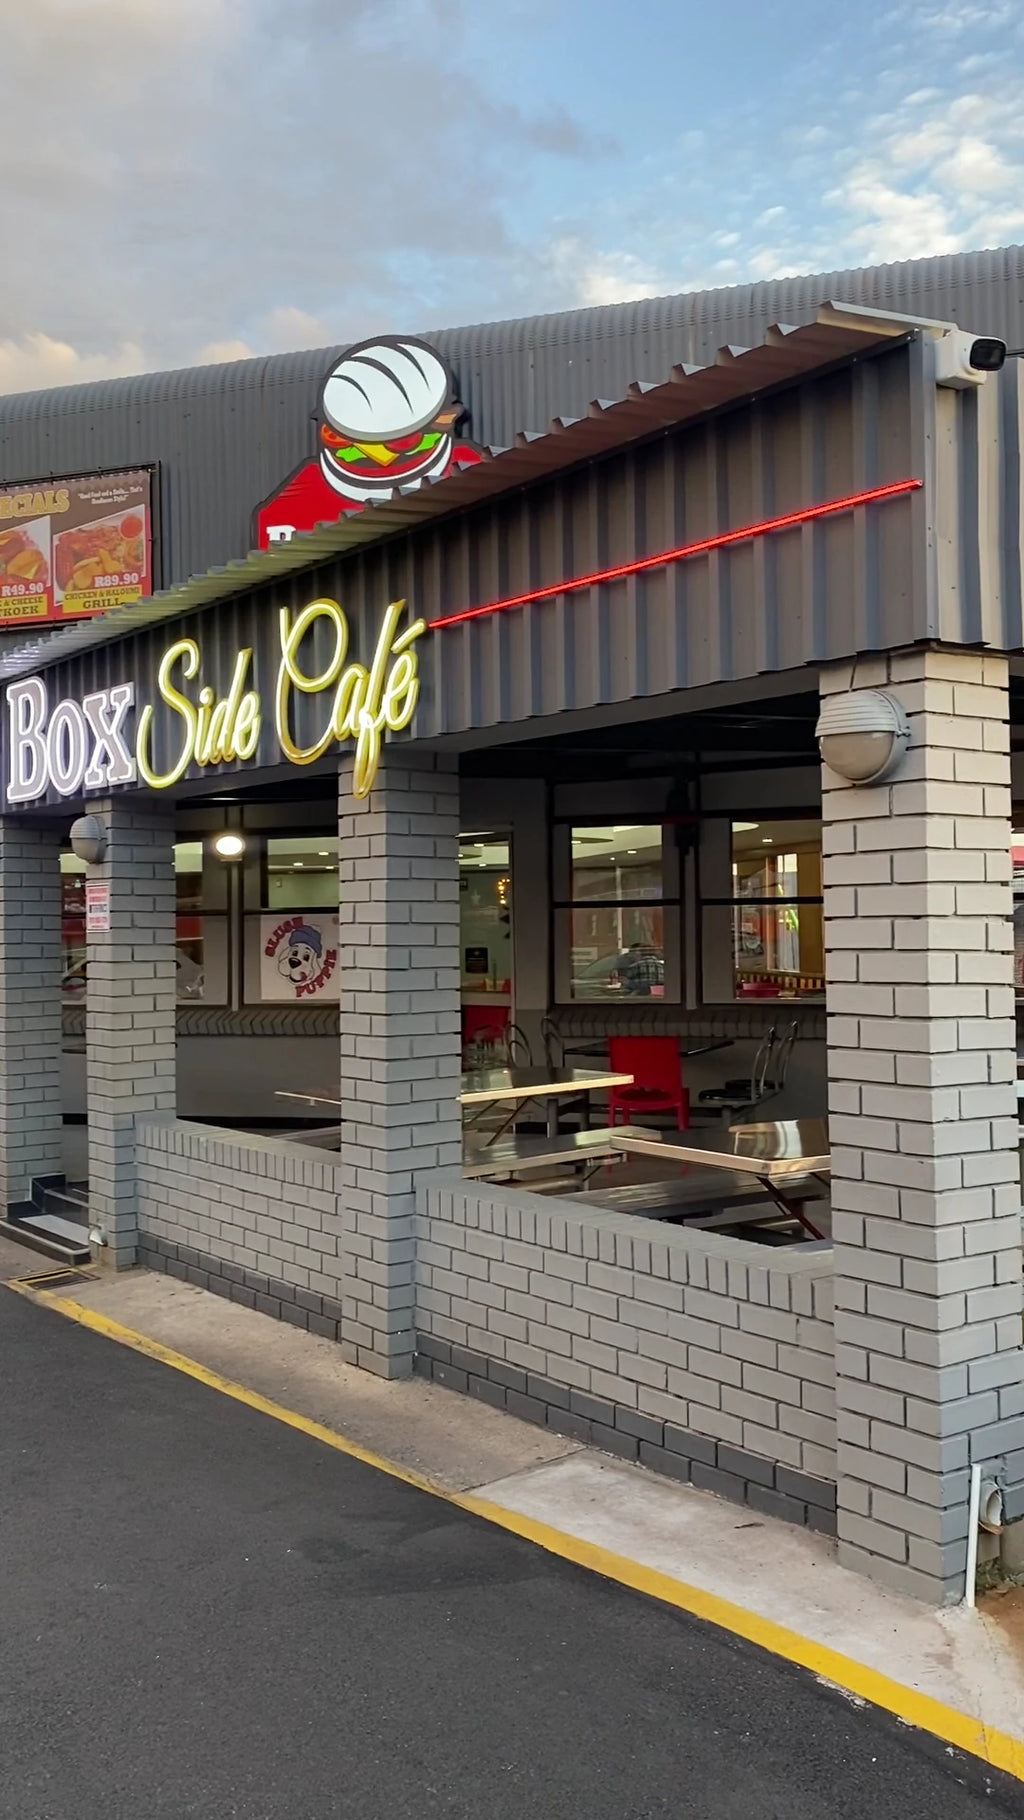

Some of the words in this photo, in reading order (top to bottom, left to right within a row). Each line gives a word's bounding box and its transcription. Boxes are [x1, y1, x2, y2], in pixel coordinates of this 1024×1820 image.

[94, 572, 139, 588] R89.90
[2, 582, 44, 597] R49.90
[65, 591, 98, 601] CHICKEN
[12, 596, 44, 606] CHEESE
[83, 597, 121, 609] GRILL
[136, 638, 263, 790] Side
[275, 598, 428, 800] Café
